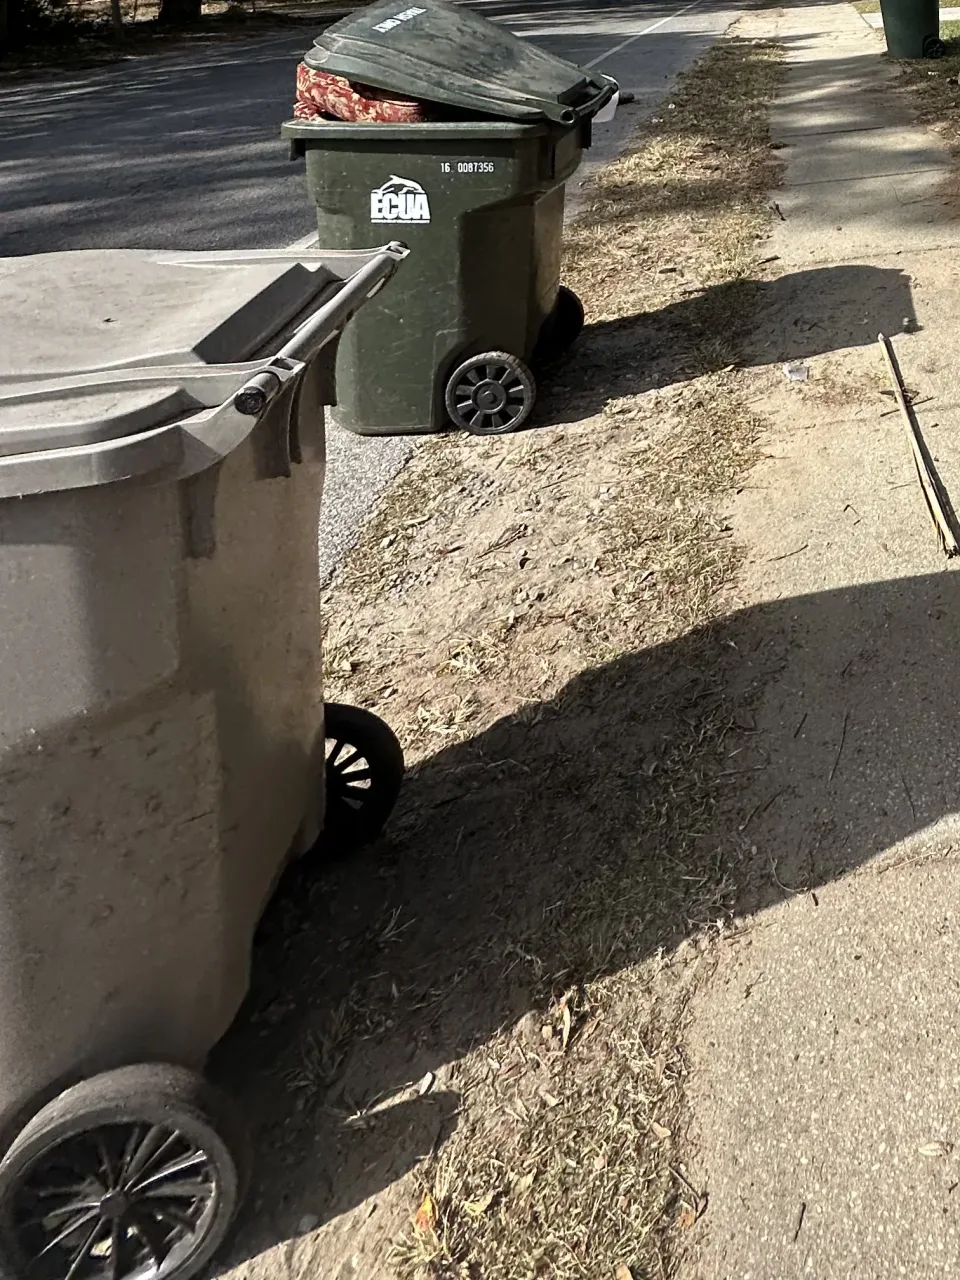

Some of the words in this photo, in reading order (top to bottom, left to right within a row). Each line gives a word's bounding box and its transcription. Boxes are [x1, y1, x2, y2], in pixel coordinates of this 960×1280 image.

[440, 162, 451, 173] 16
[457, 162, 494, 173] 0087356
[371, 192, 431, 220] ECUA
